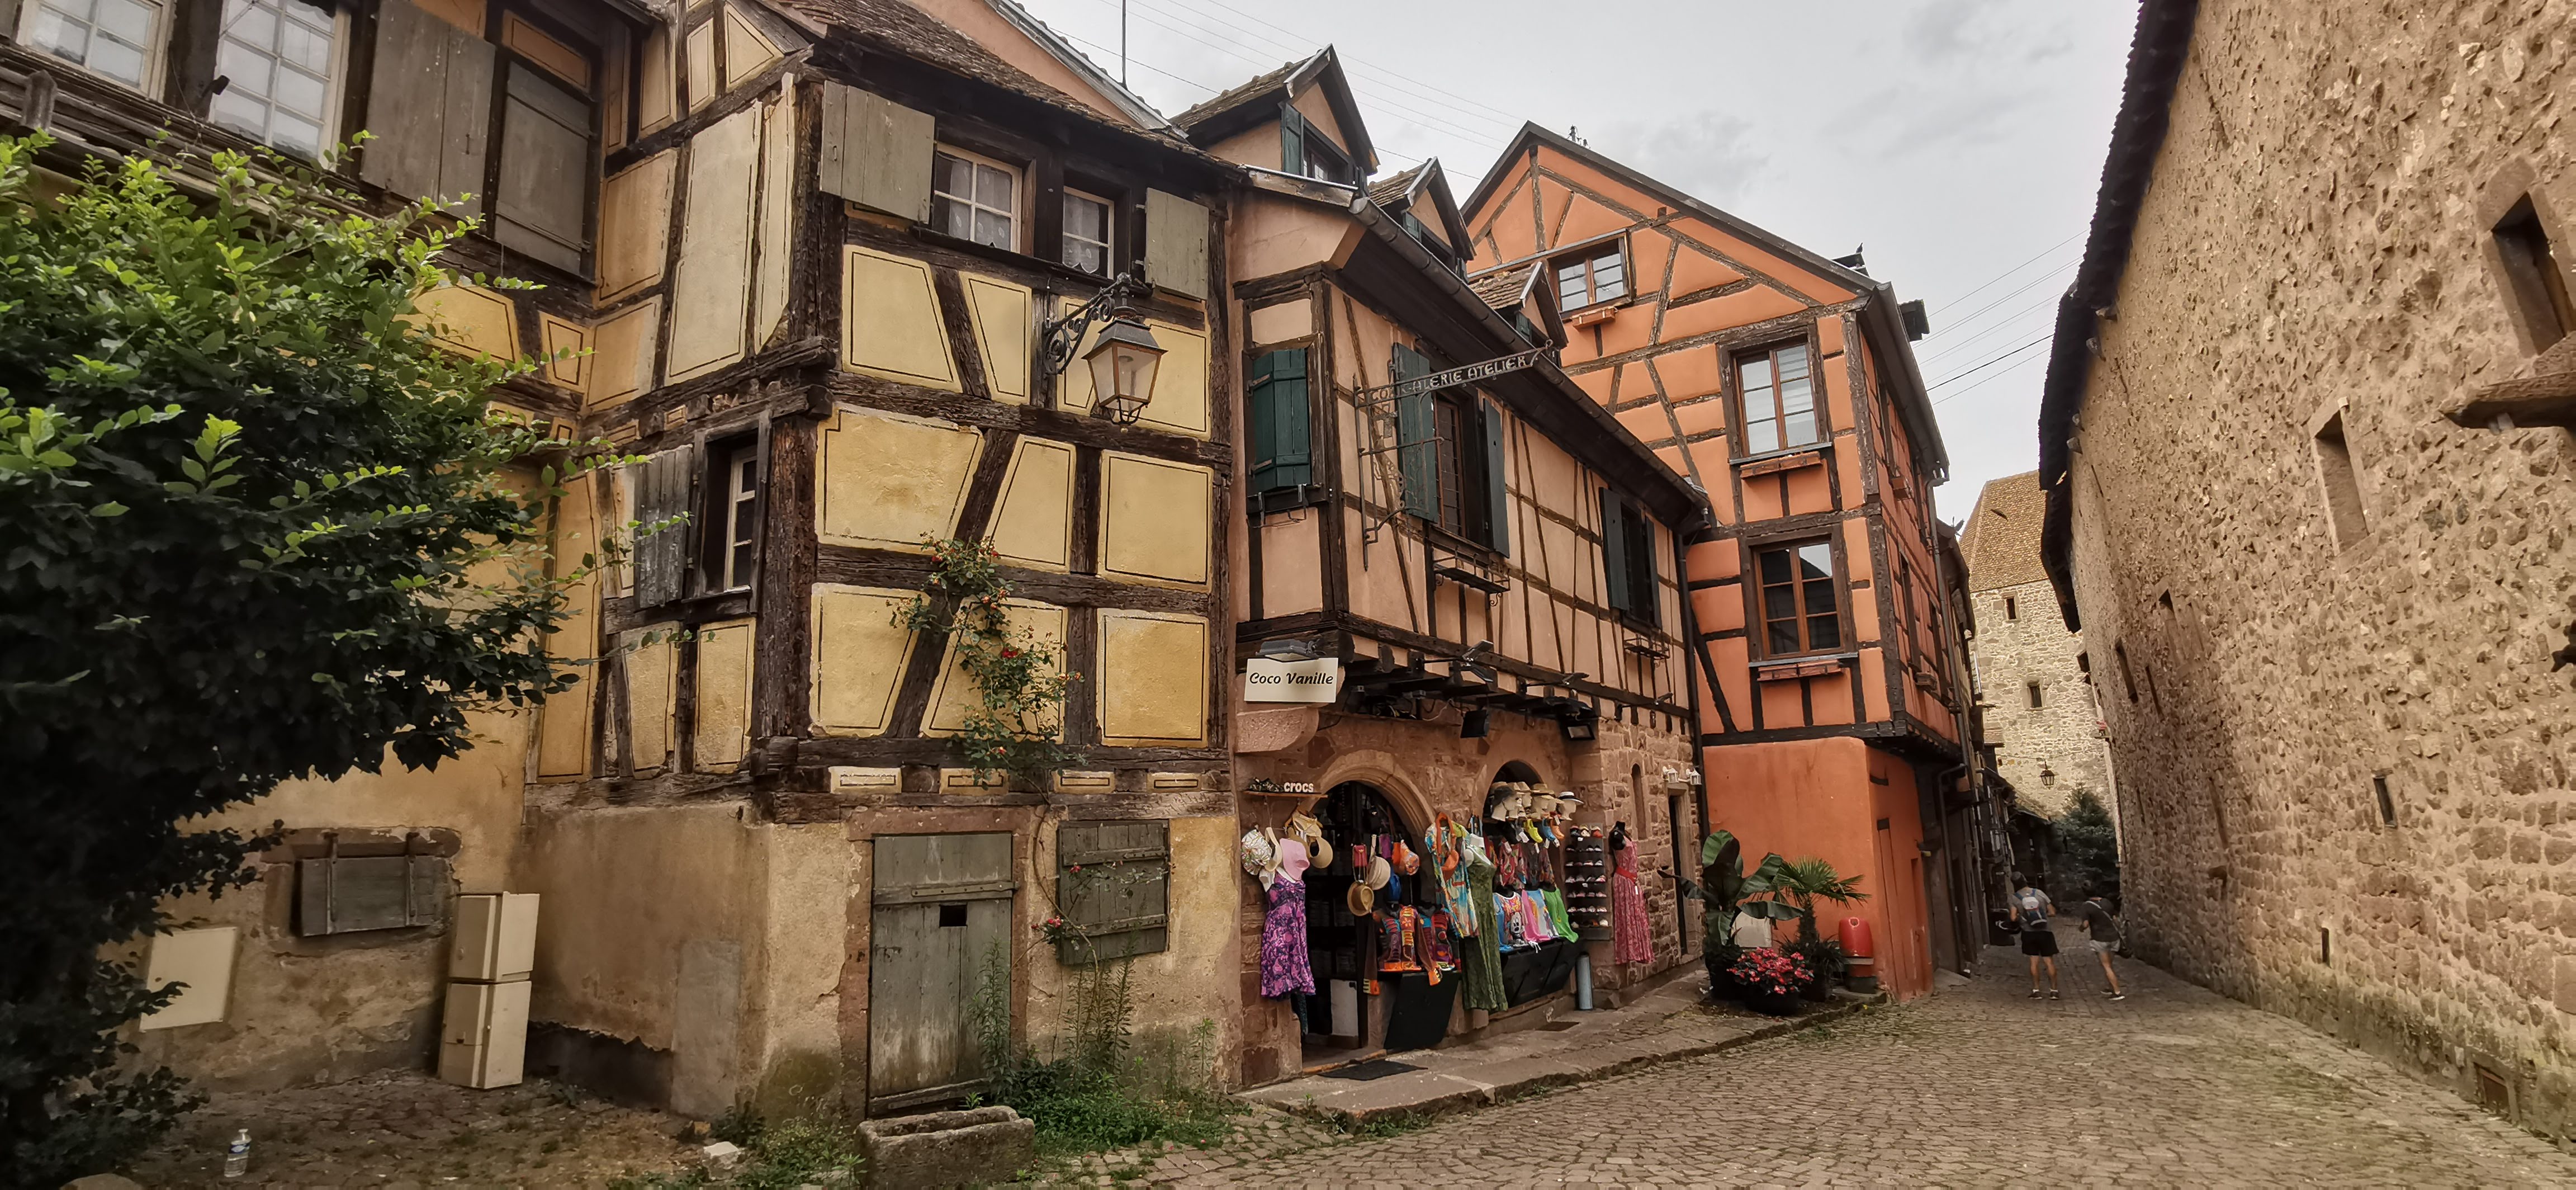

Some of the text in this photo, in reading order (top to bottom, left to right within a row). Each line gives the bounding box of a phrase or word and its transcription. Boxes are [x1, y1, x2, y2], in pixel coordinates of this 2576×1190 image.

[1467, 355, 1527, 379] ATELIER
[1249, 672, 1333, 684] Coco Vanille
[1284, 782, 1314, 792] crocs
